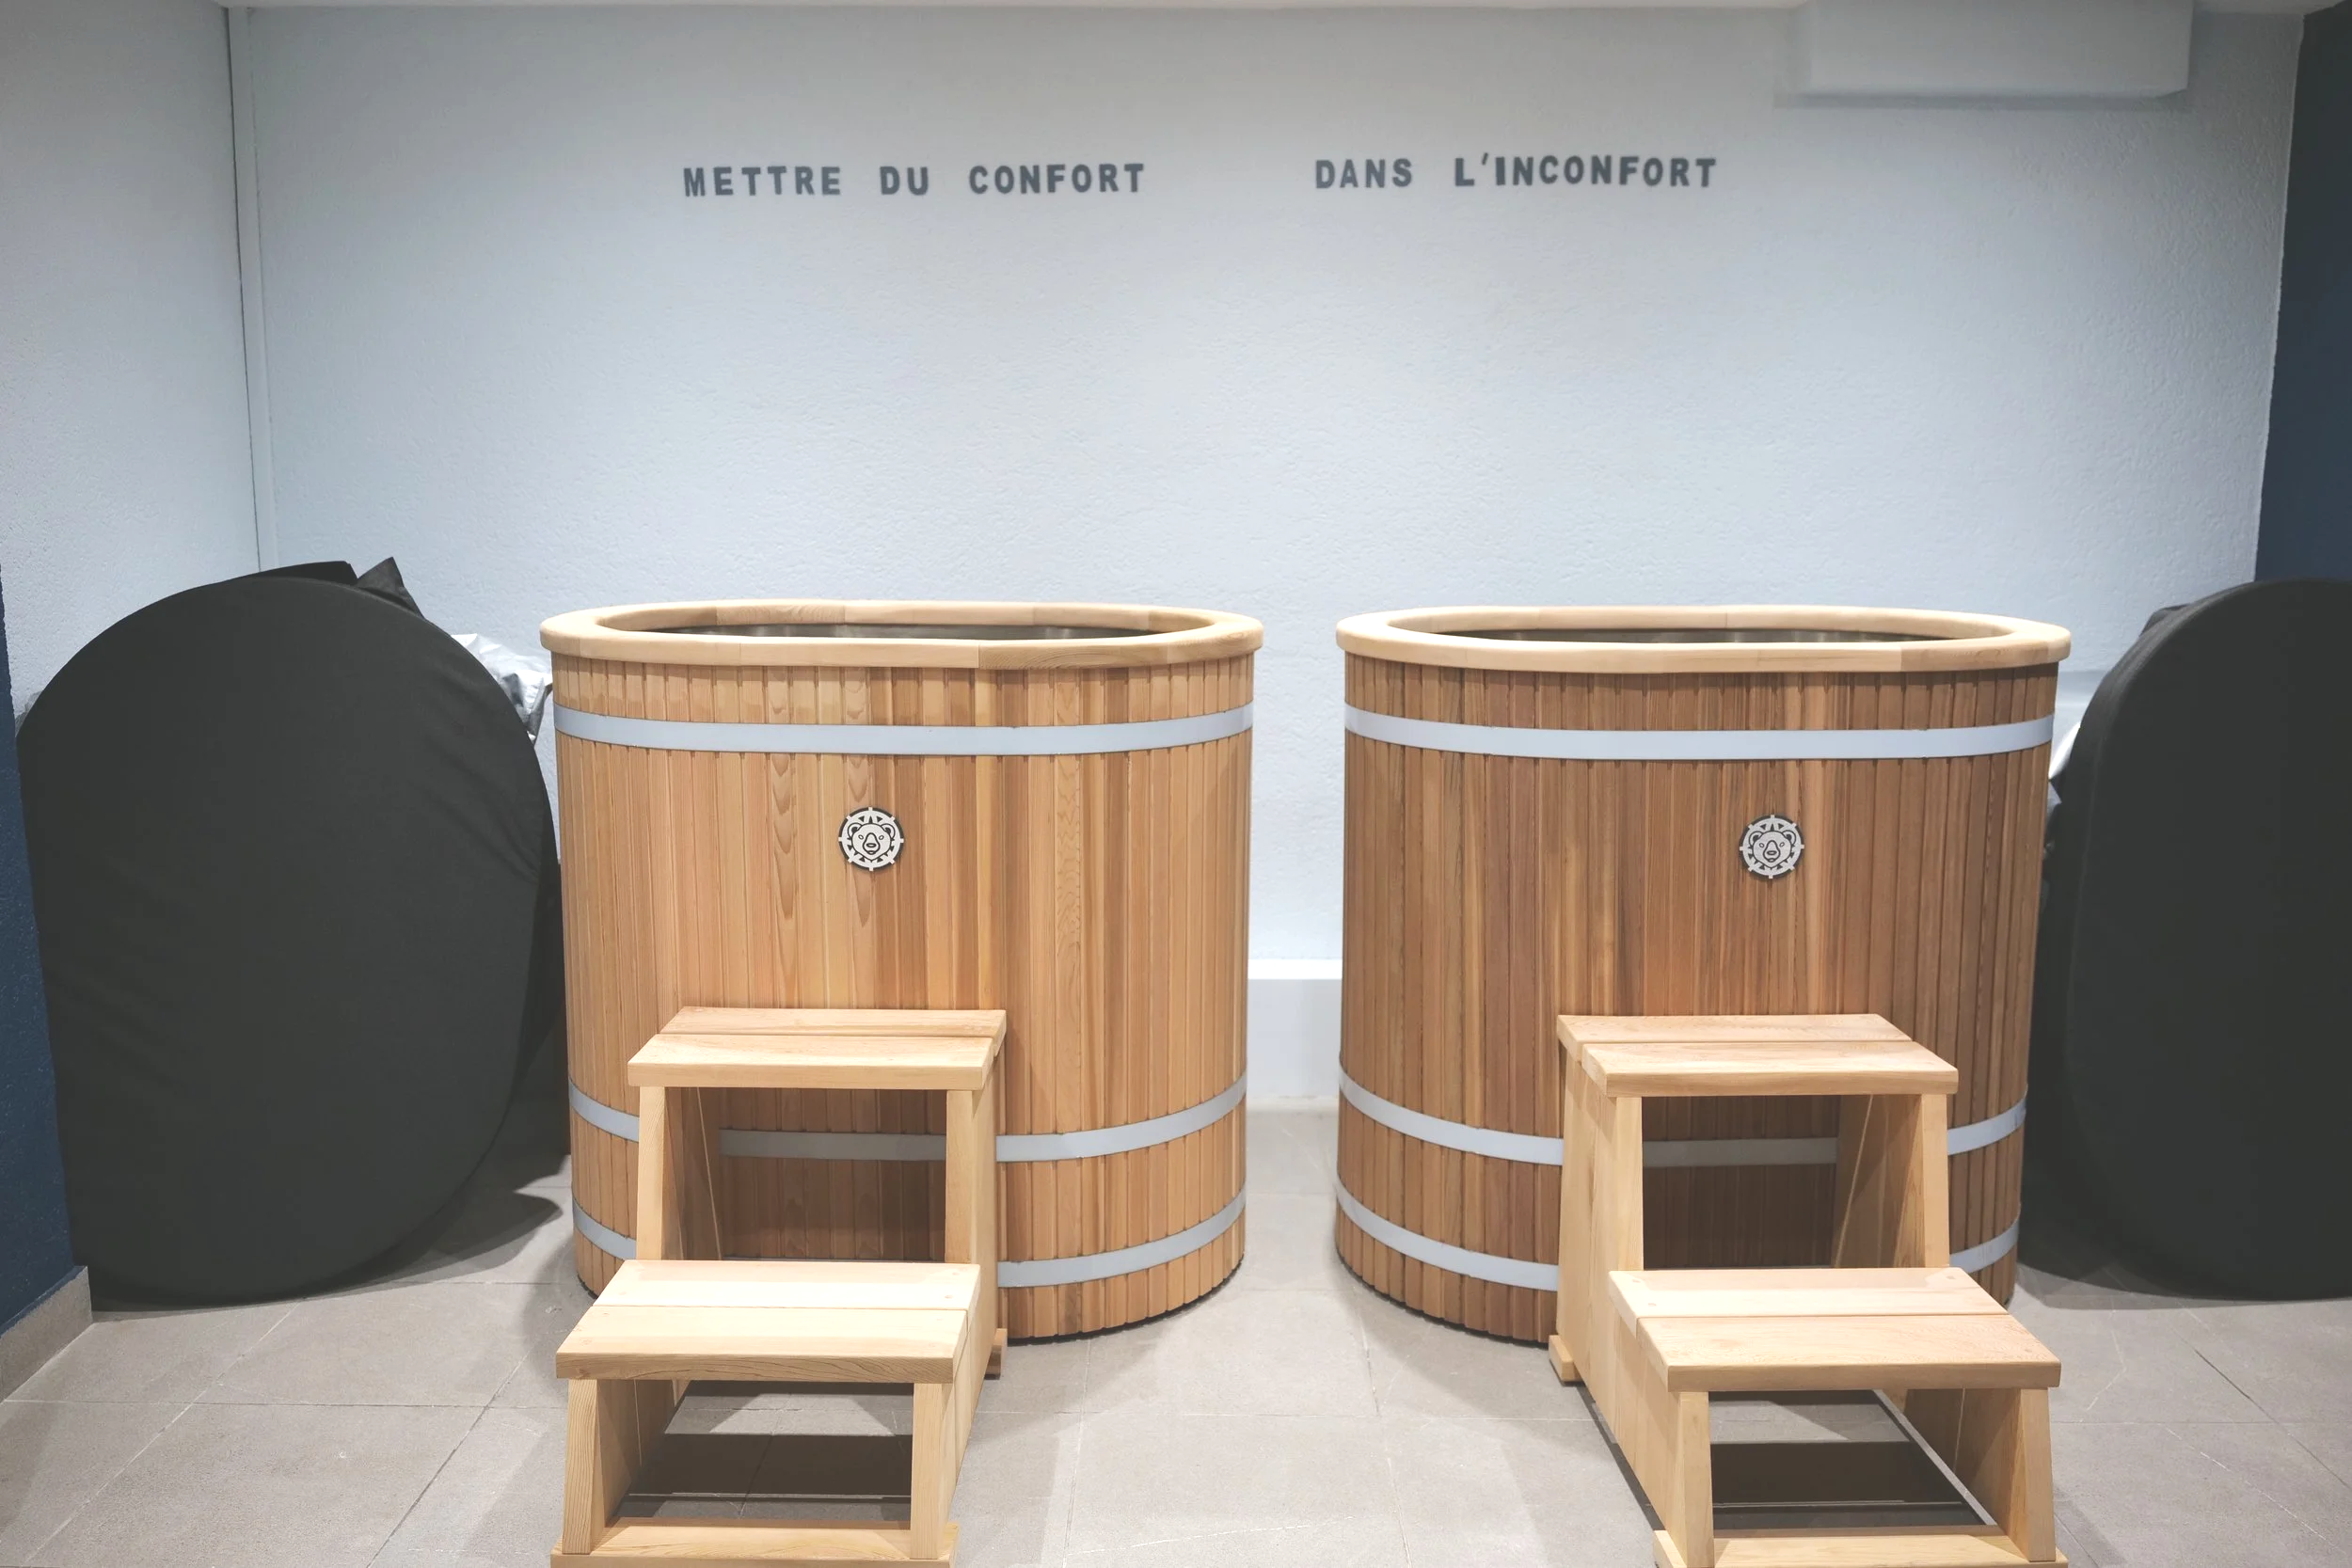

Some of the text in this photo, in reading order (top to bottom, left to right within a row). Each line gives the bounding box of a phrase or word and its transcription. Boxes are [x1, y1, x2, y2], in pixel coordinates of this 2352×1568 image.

[683, 151, 1718, 198] METTRE DU CONFORT DANS L'INCONFORT
